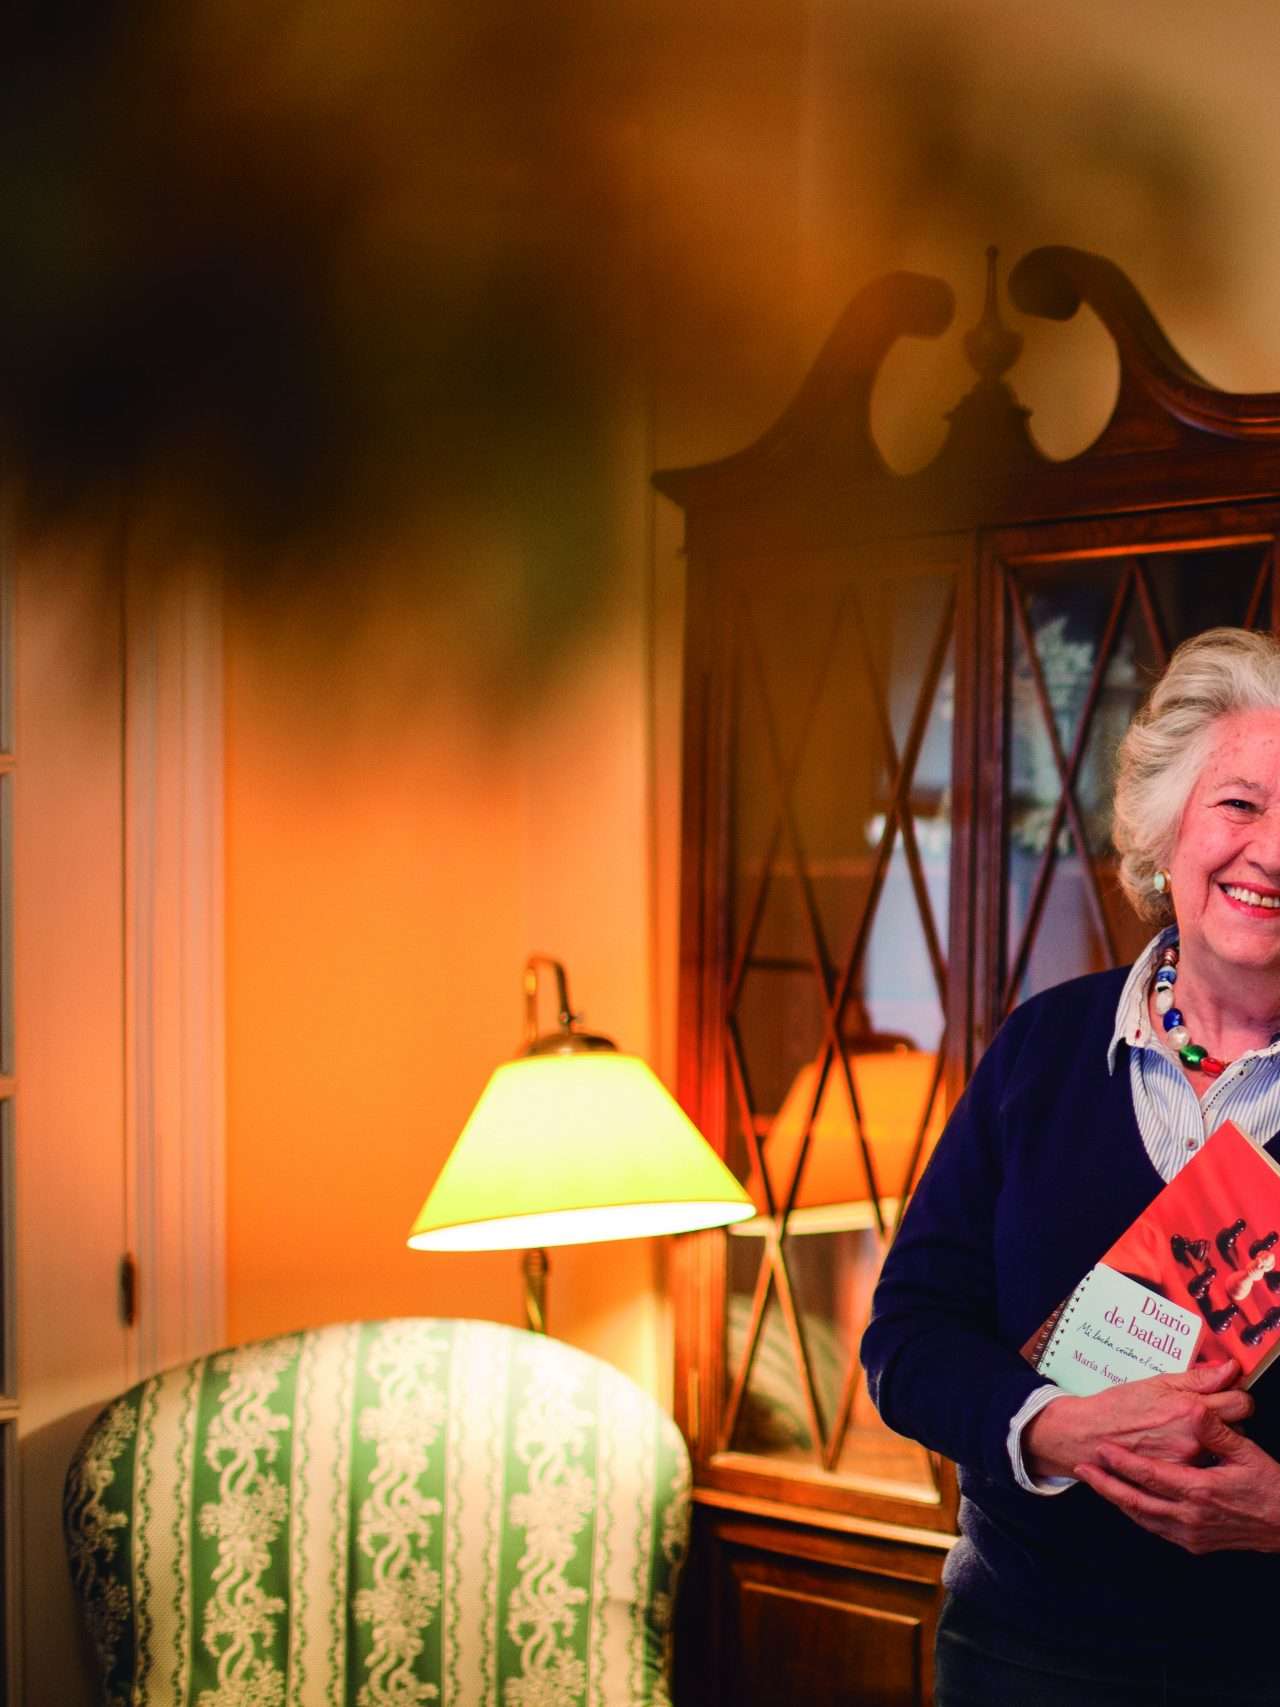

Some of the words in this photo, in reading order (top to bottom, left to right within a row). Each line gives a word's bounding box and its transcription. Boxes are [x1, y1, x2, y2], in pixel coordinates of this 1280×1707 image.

[1104, 1306, 1125, 1329] de
[1127, 1316, 1182, 1361] batalla
[1141, 1296, 1191, 1336] Diario
[1073, 1349, 1098, 1371] María
[1101, 1364, 1128, 1385] Ángel
